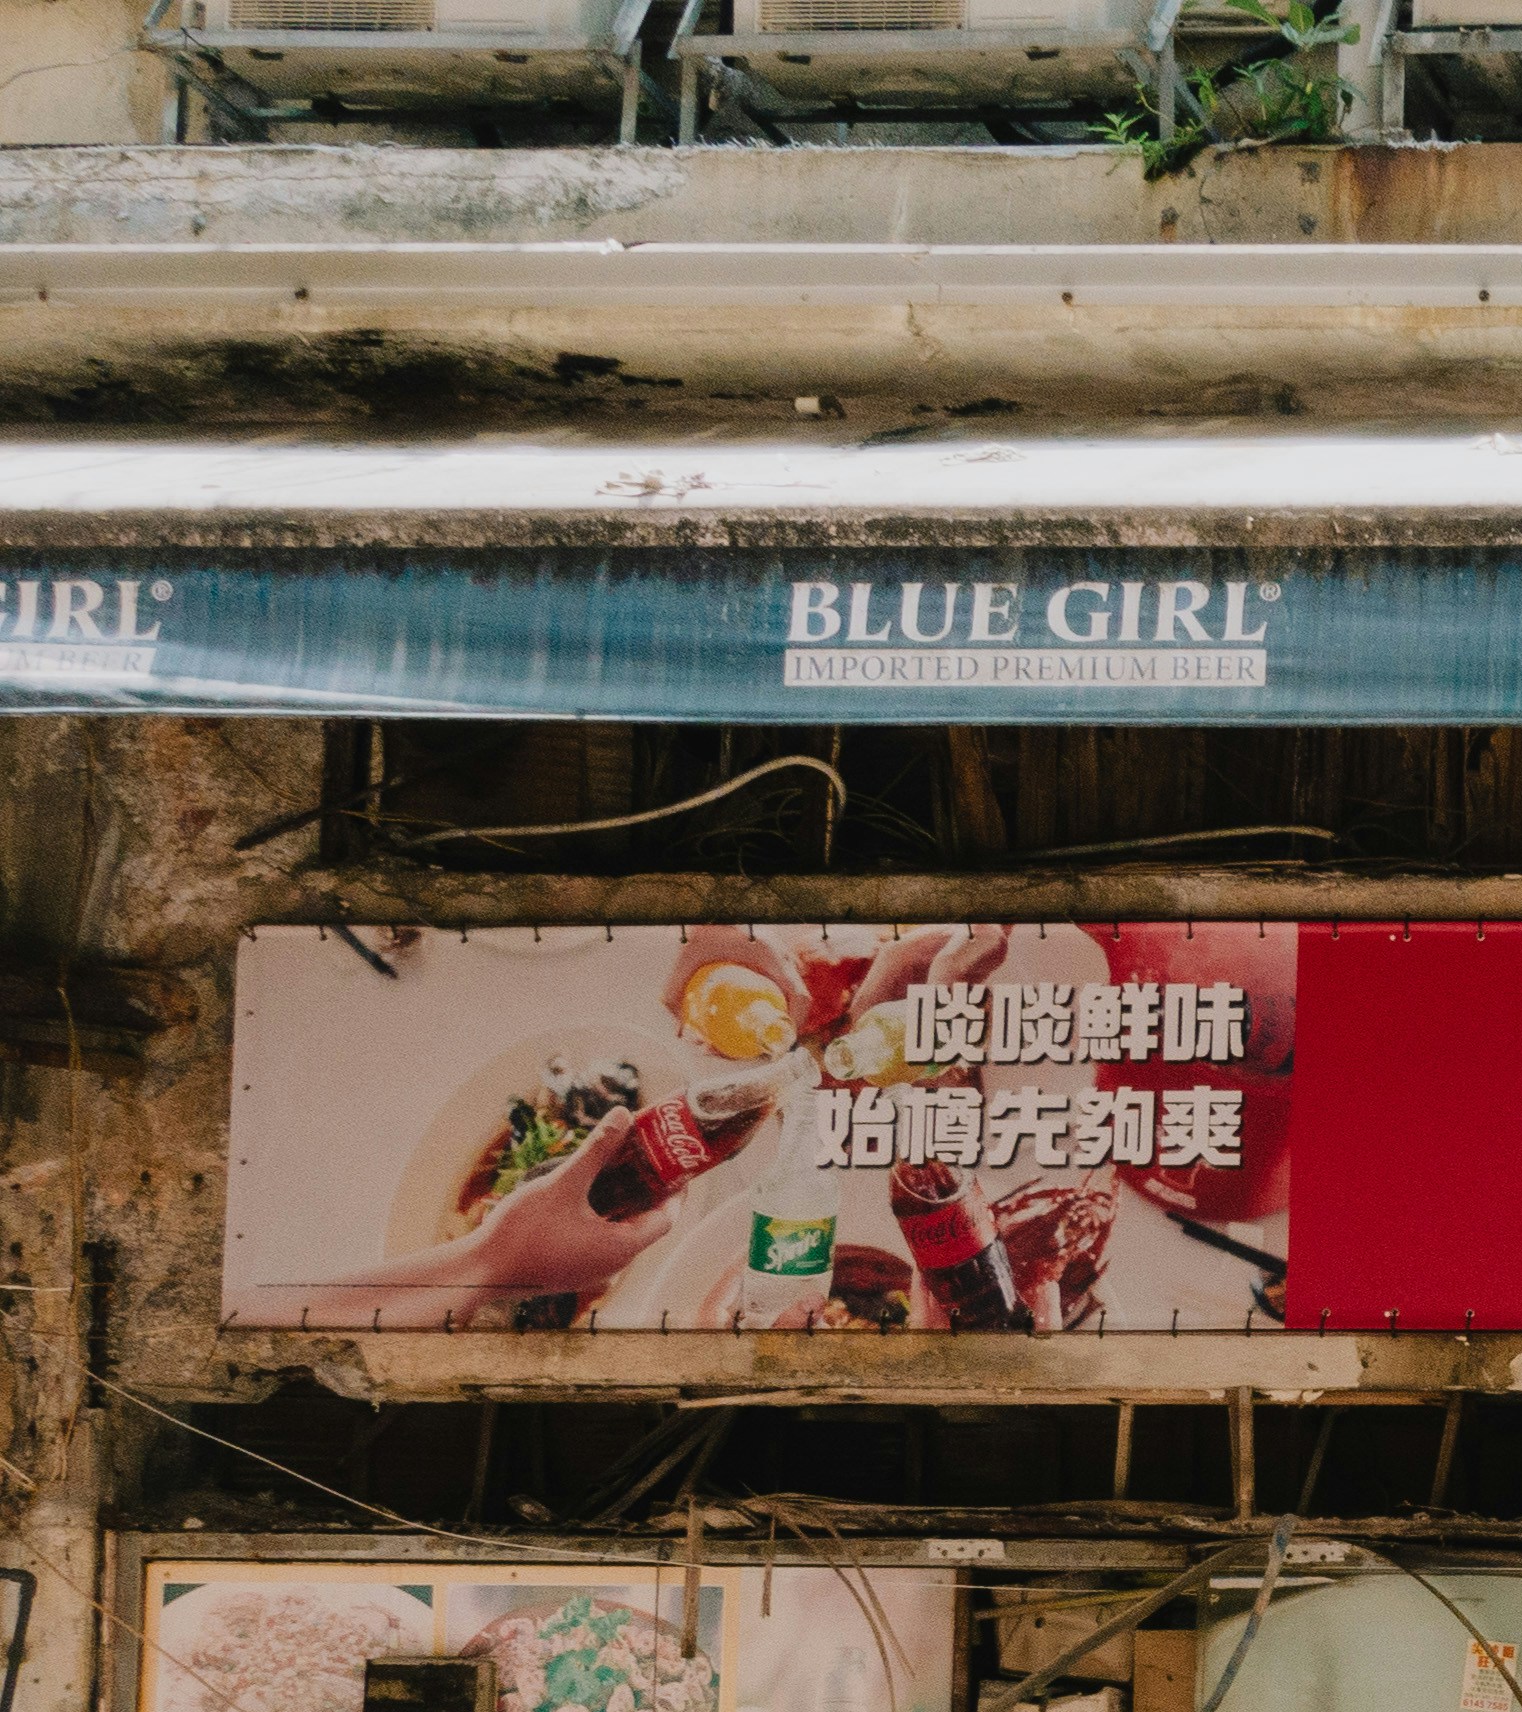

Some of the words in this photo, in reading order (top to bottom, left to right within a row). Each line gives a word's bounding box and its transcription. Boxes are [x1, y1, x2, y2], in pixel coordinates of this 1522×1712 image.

[0, 579, 162, 642] IRL
[786, 581, 1018, 642] BLUE
[1047, 580, 1268, 642] GIRL
[793, 654, 979, 681] IMPORTED
[993, 654, 1158, 681] PREMIUM
[1172, 654, 1256, 681] BEER
[904, 981, 1246, 1063] 啖啖鮮味
[816, 1086, 1242, 1168] 始樽先夠爽
